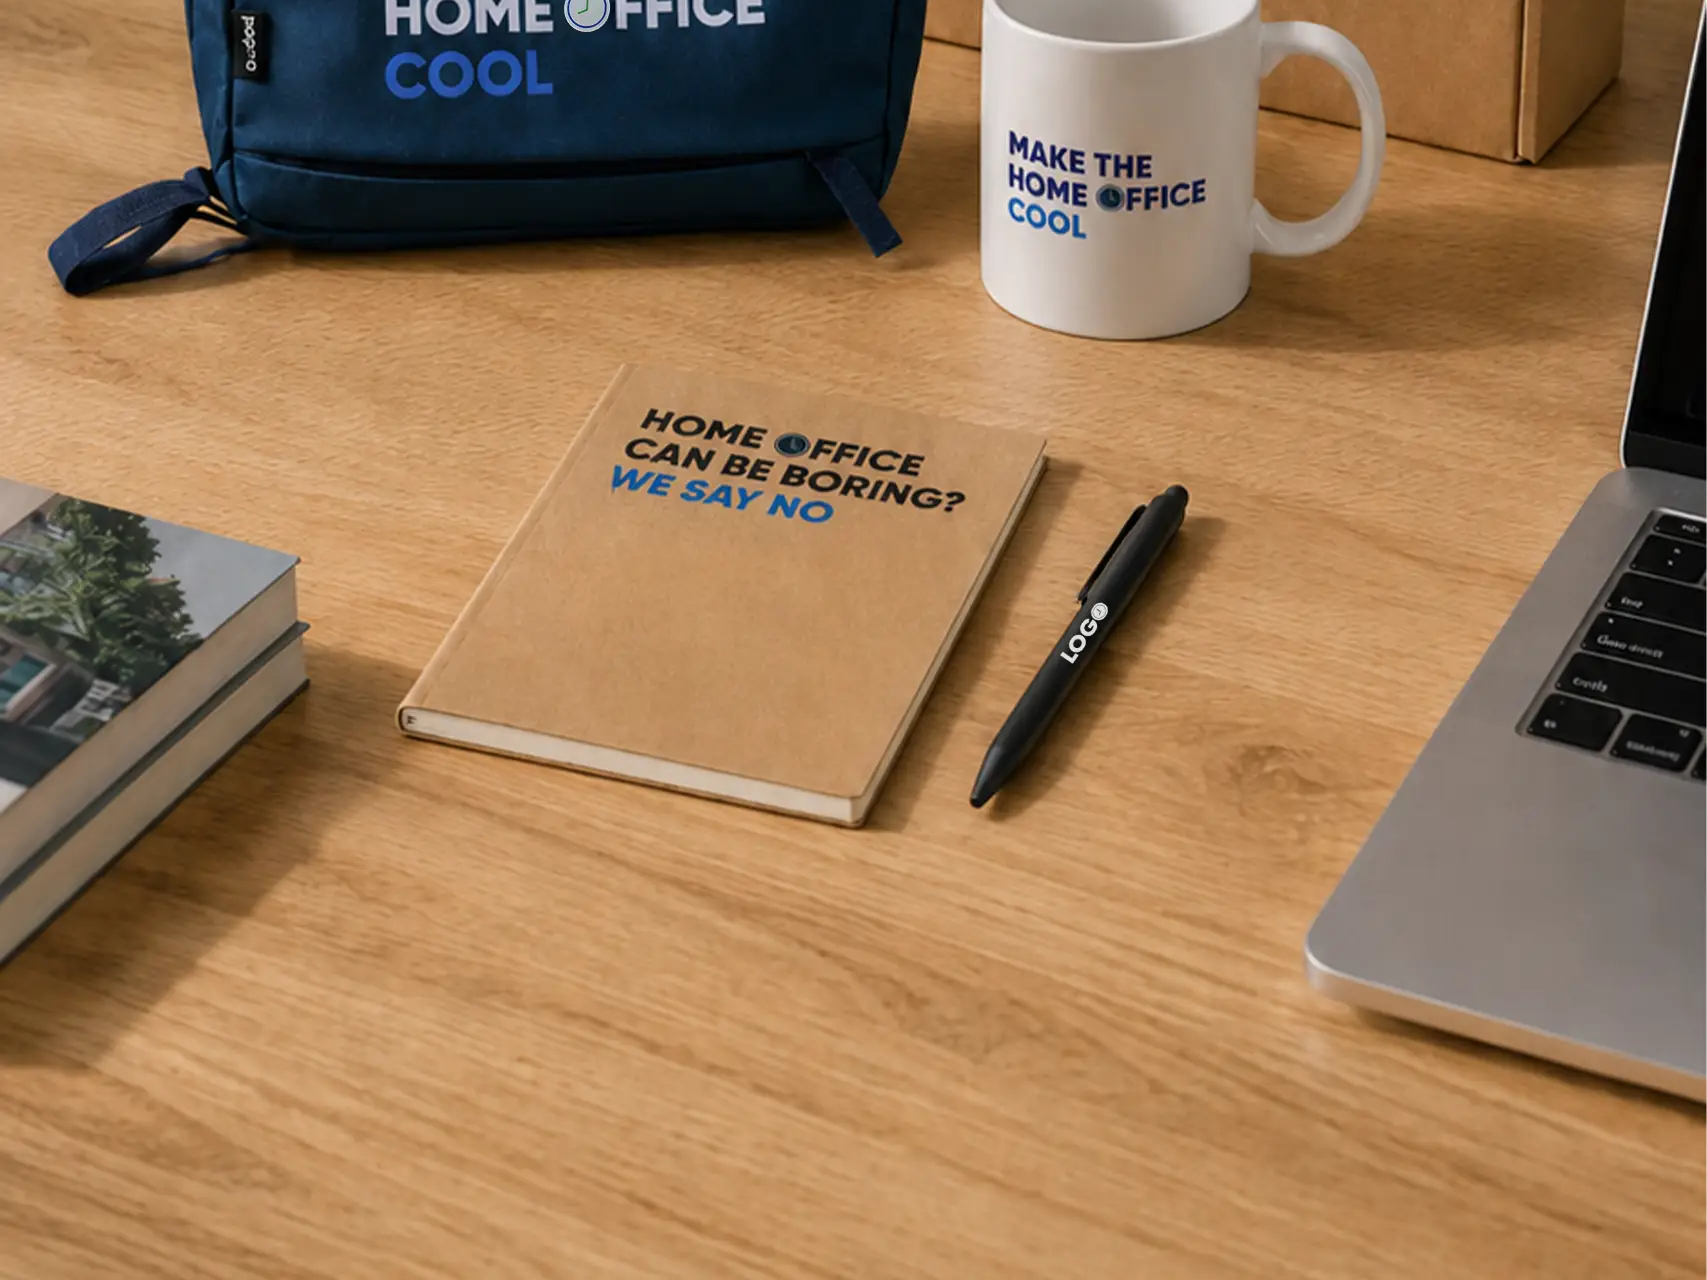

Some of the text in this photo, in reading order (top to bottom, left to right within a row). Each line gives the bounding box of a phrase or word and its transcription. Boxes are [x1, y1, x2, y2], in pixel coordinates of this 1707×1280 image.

[384, 49, 554, 99] COOL
[1009, 130, 1153, 179] MAKE THE
[1008, 163, 1088, 208] HOME
[1008, 196, 1087, 240] COOL
[640, 408, 768, 450] HOME
[611, 464, 834, 524] WE SAY NO
[624, 437, 966, 513] CAN BE BORING?
